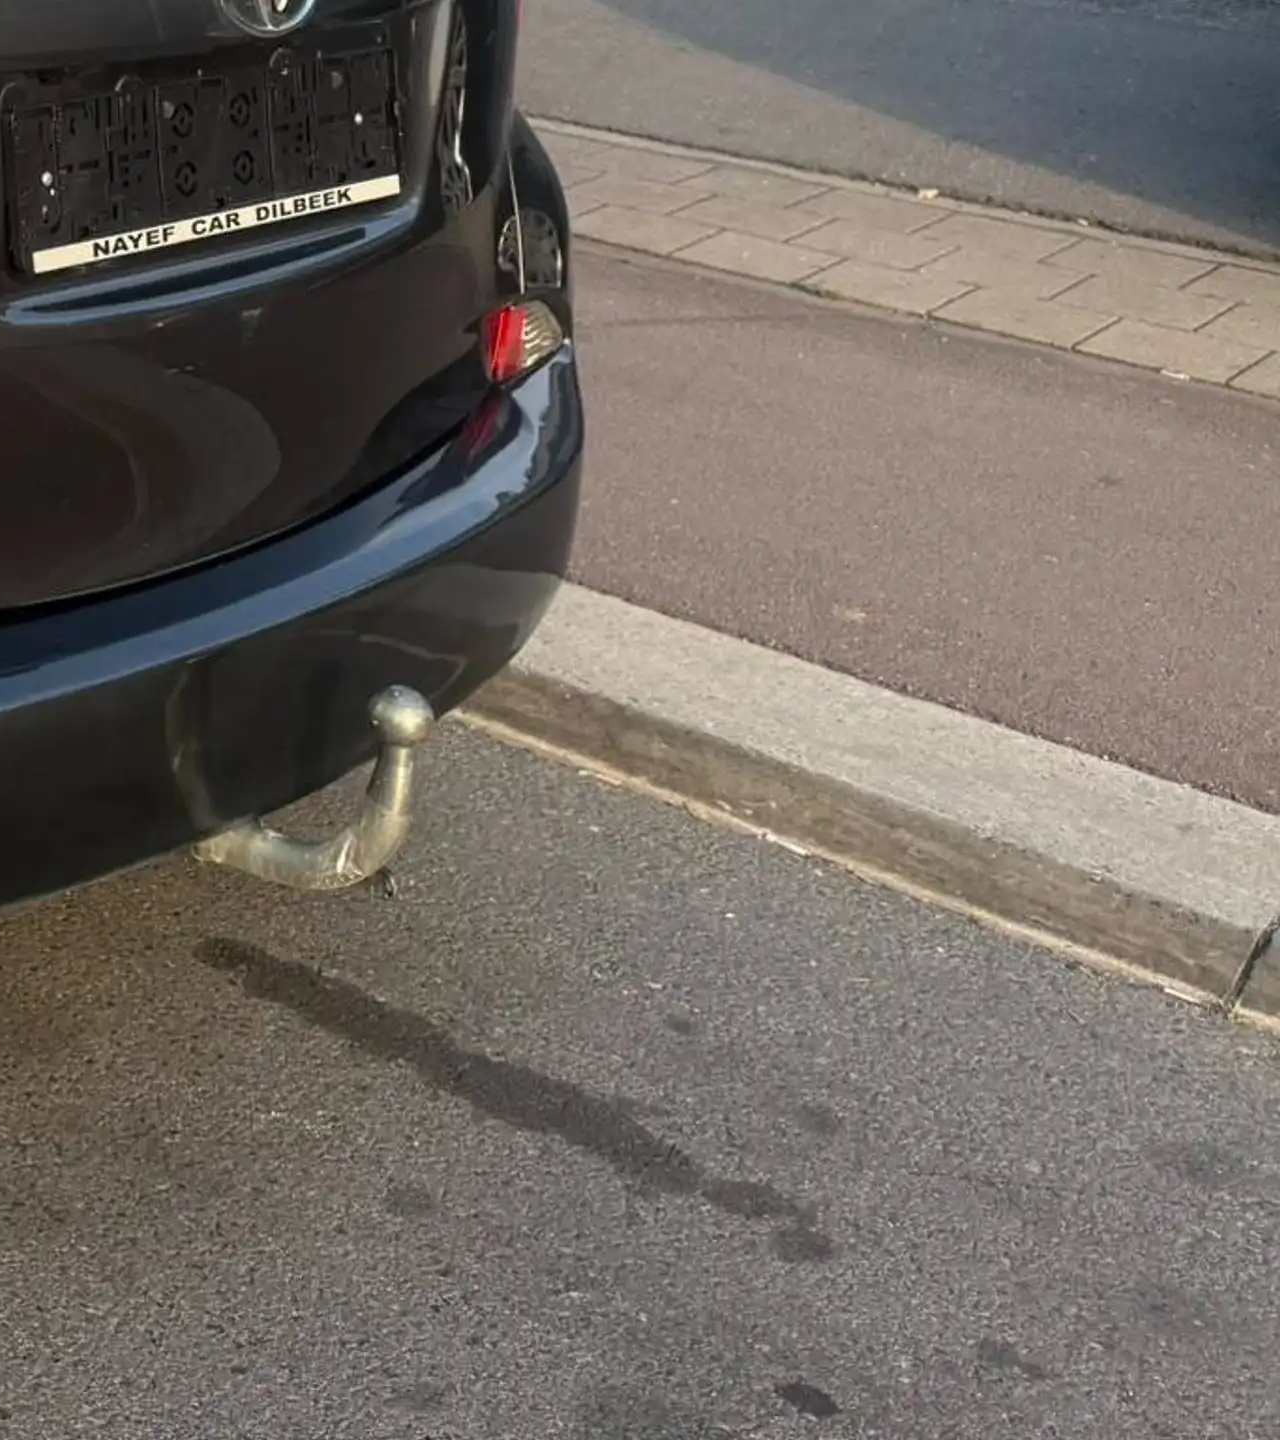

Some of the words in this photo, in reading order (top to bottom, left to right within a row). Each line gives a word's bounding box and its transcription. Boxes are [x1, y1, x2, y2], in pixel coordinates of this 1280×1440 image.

[91, 222, 176, 259] NAYEF
[190, 209, 242, 238] CAR
[254, 186, 353, 225] DILBEEK
